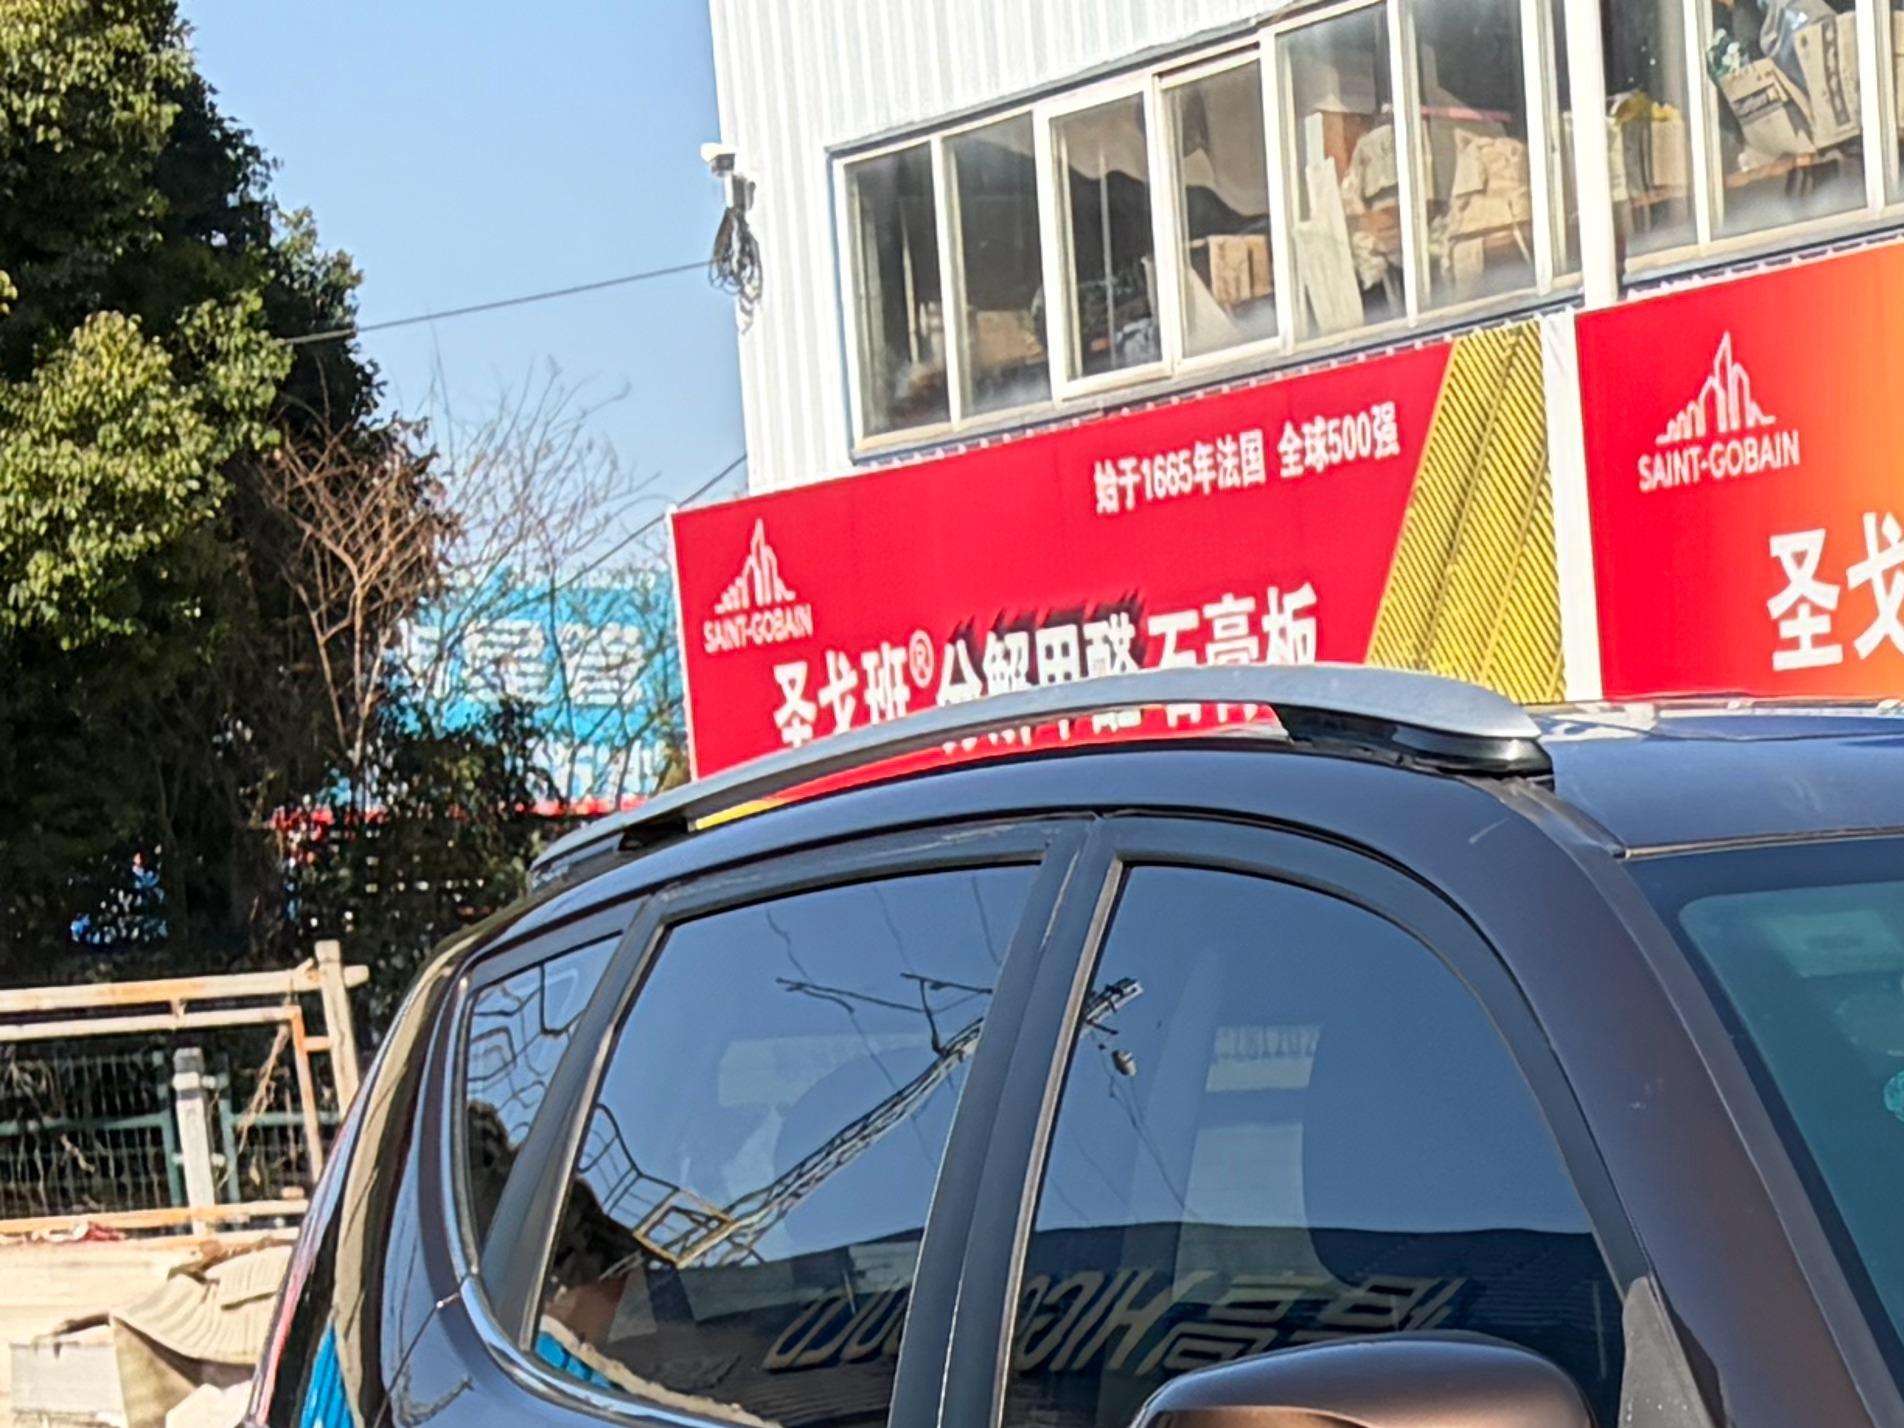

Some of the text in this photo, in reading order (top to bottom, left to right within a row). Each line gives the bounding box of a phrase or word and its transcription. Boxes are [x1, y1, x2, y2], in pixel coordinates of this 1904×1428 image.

[1093, 400, 1400, 514] 始于1665年法国 全球500强
[1637, 429, 1800, 493] SAINT-GOBAIN
[703, 603, 814, 654] SAINT-GOBAIN
